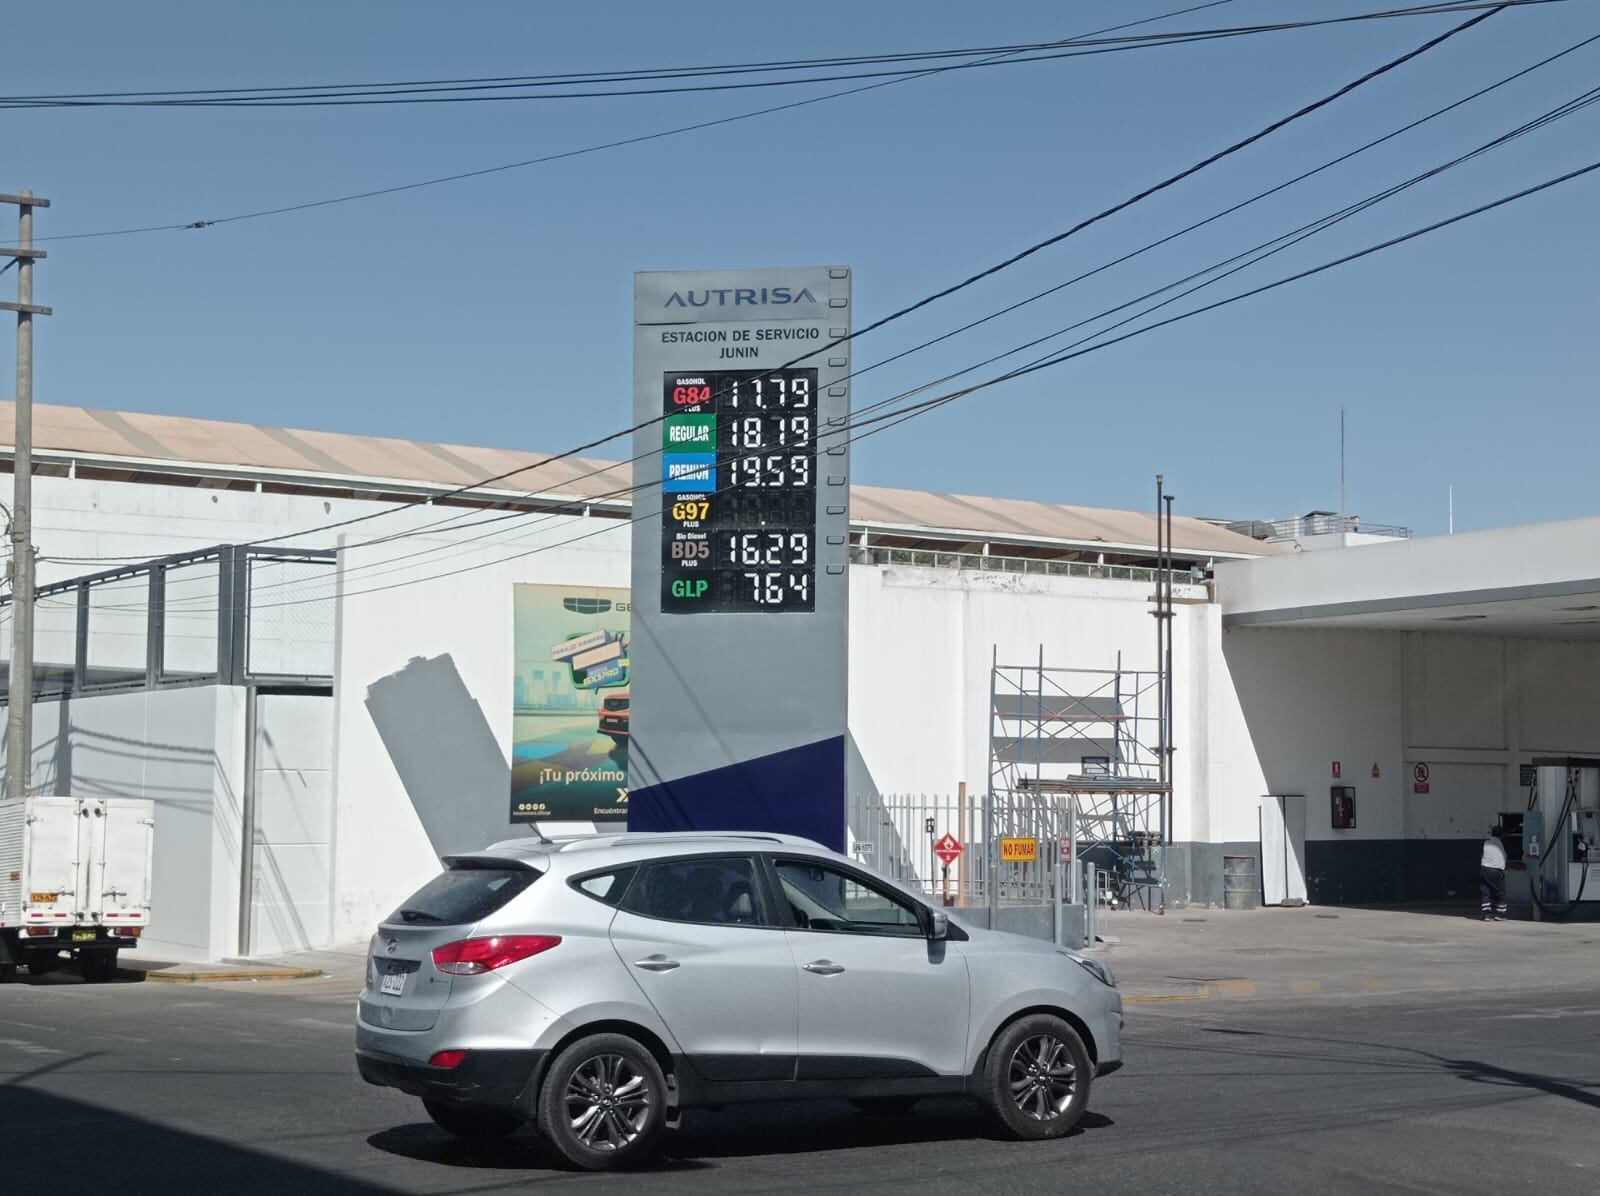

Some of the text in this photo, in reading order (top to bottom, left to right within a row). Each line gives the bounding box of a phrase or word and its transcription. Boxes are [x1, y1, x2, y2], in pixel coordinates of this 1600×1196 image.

[664, 287, 817, 307] AUTRISA
[661, 328, 820, 343] ESTACION DE SERVICIO
[719, 347, 759, 359] JUNIN
[676, 378, 706, 386] GASOHOL
[673, 386, 711, 404] G84
[669, 425, 709, 442] REGULAR
[731, 416, 809, 448] 18.19
[731, 456, 809, 487] 19.59
[672, 502, 710, 520] G97
[671, 541, 710, 559] BD5
[730, 533, 808, 565] 16.29
[671, 580, 709, 598] GLP
[744, 572, 808, 604] 7.64
[539, 768, 625, 785] ¡Tu próximo
[1003, 843, 1034, 856] NO FUMAR
